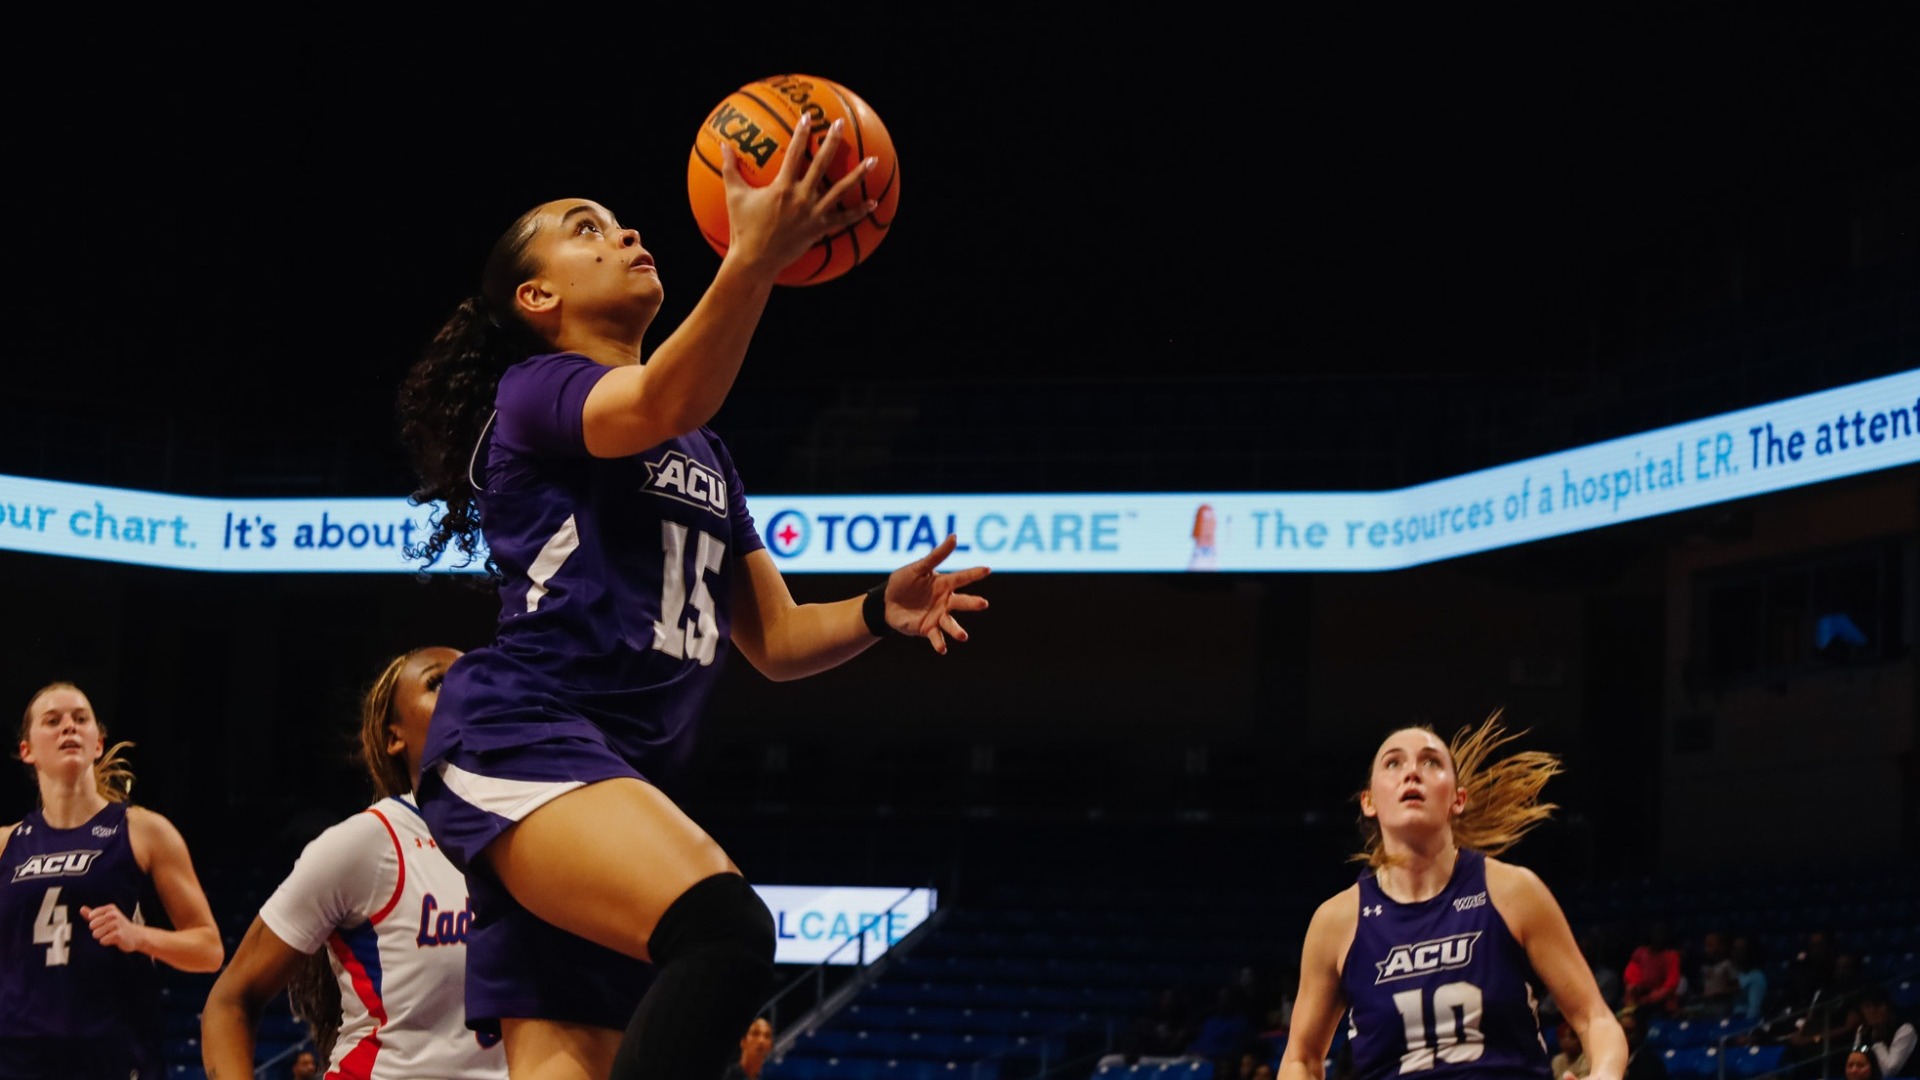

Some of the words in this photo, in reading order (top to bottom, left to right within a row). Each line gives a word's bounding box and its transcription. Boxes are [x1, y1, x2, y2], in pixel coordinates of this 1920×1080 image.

[708, 102, 779, 169] NCAA
[1748, 421, 1806, 470] The
[652, 457, 727, 511] ACU
[1251, 508, 1329, 549] The
[1345, 497, 1495, 549] resources
[1503, 476, 1531, 523] of
[1538, 485, 1553, 515] a
[1562, 440, 1685, 513] hospital
[1696, 430, 1740, 483] ER.
[0, 502, 57, 533] ur
[68, 500, 197, 549] chart.
[223, 511, 277, 550] It's
[293, 511, 416, 549] about
[816, 513, 1120, 553] TOTALCARE
[652, 519, 727, 667] 15
[17, 852, 92, 878] ACU
[32, 885, 73, 968] 4
[1382, 936, 1470, 978] ACU
[1392, 981, 1485, 1075] 10
